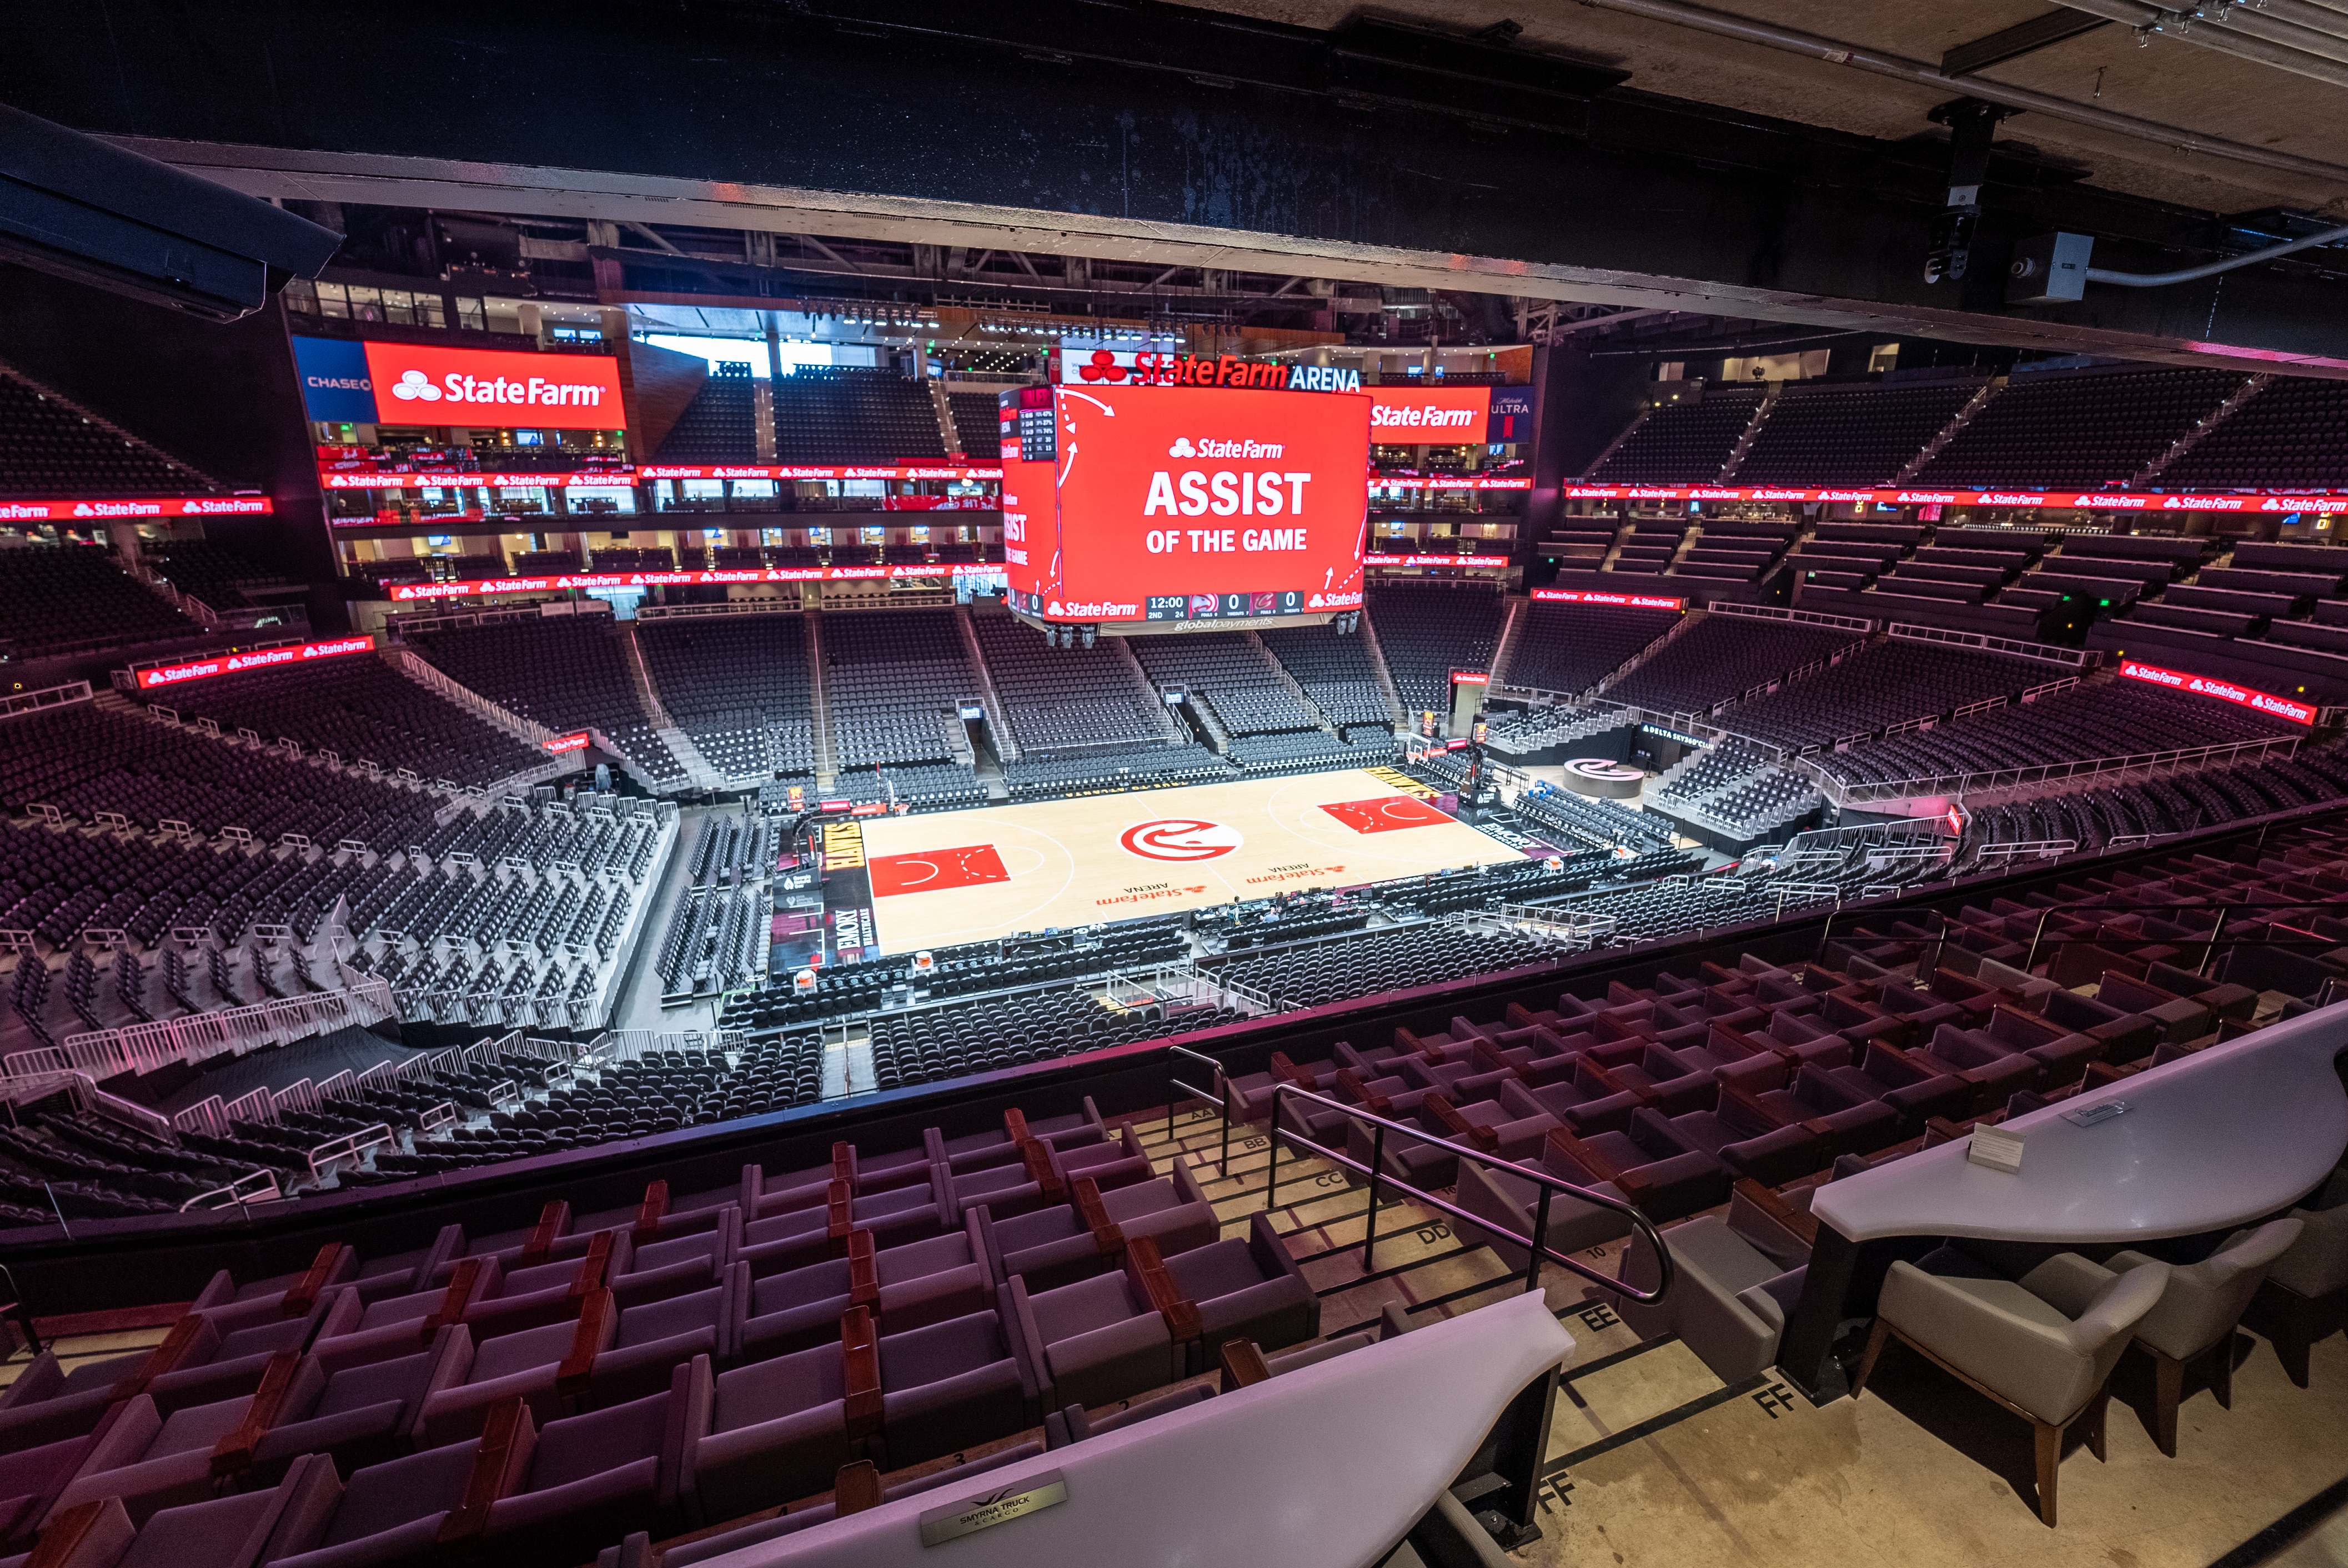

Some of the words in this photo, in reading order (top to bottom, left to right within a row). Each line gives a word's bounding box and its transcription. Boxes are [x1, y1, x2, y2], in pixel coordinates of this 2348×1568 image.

[307, 376, 360, 390] CHASE
[1290, 366, 1360, 393] ARENA
[1491, 404, 1529, 414] ULTRA
[1143, 471, 1311, 516] ASSIST
[1146, 530, 1180, 554] OF
[1186, 529, 1235, 552] THE
[1242, 528, 1307, 551] GAME
[1032, 595, 1038, 610] 0
[1151, 597, 1183, 609] 12:00
[1228, 594, 1240, 609] 0
[1286, 591, 1296, 606] 0
[1650, 726, 1672, 738] DELTA
[1361, 766, 1443, 800] HAWKS
[1482, 822, 1542, 848] EMORY
[824, 822, 865, 871] HAWKS
[1268, 863, 1310, 873] ARENA
[1123, 883, 1168, 893] ARENA
[835, 909, 861, 950] EMORY
[1192, 1110, 1213, 1120] AA
[1243, 1138, 1267, 1150] BB
[1315, 1172, 1344, 1188] CC
[1441, 1186, 1456, 1195] 10
[1416, 1224, 1451, 1244] DD
[1586, 1246, 1607, 1259] 10
[1578, 1304, 1621, 1332] EE
[1751, 1383, 1794, 1419] FF
[954, 1453, 966, 1465] 3
[1538, 1471, 1576, 1515] FF
[960, 1507, 999, 1525] SMYRNA
[1000, 1496, 1030, 1510] TRUCK
[982, 1507, 1019, 1523] CARGO
